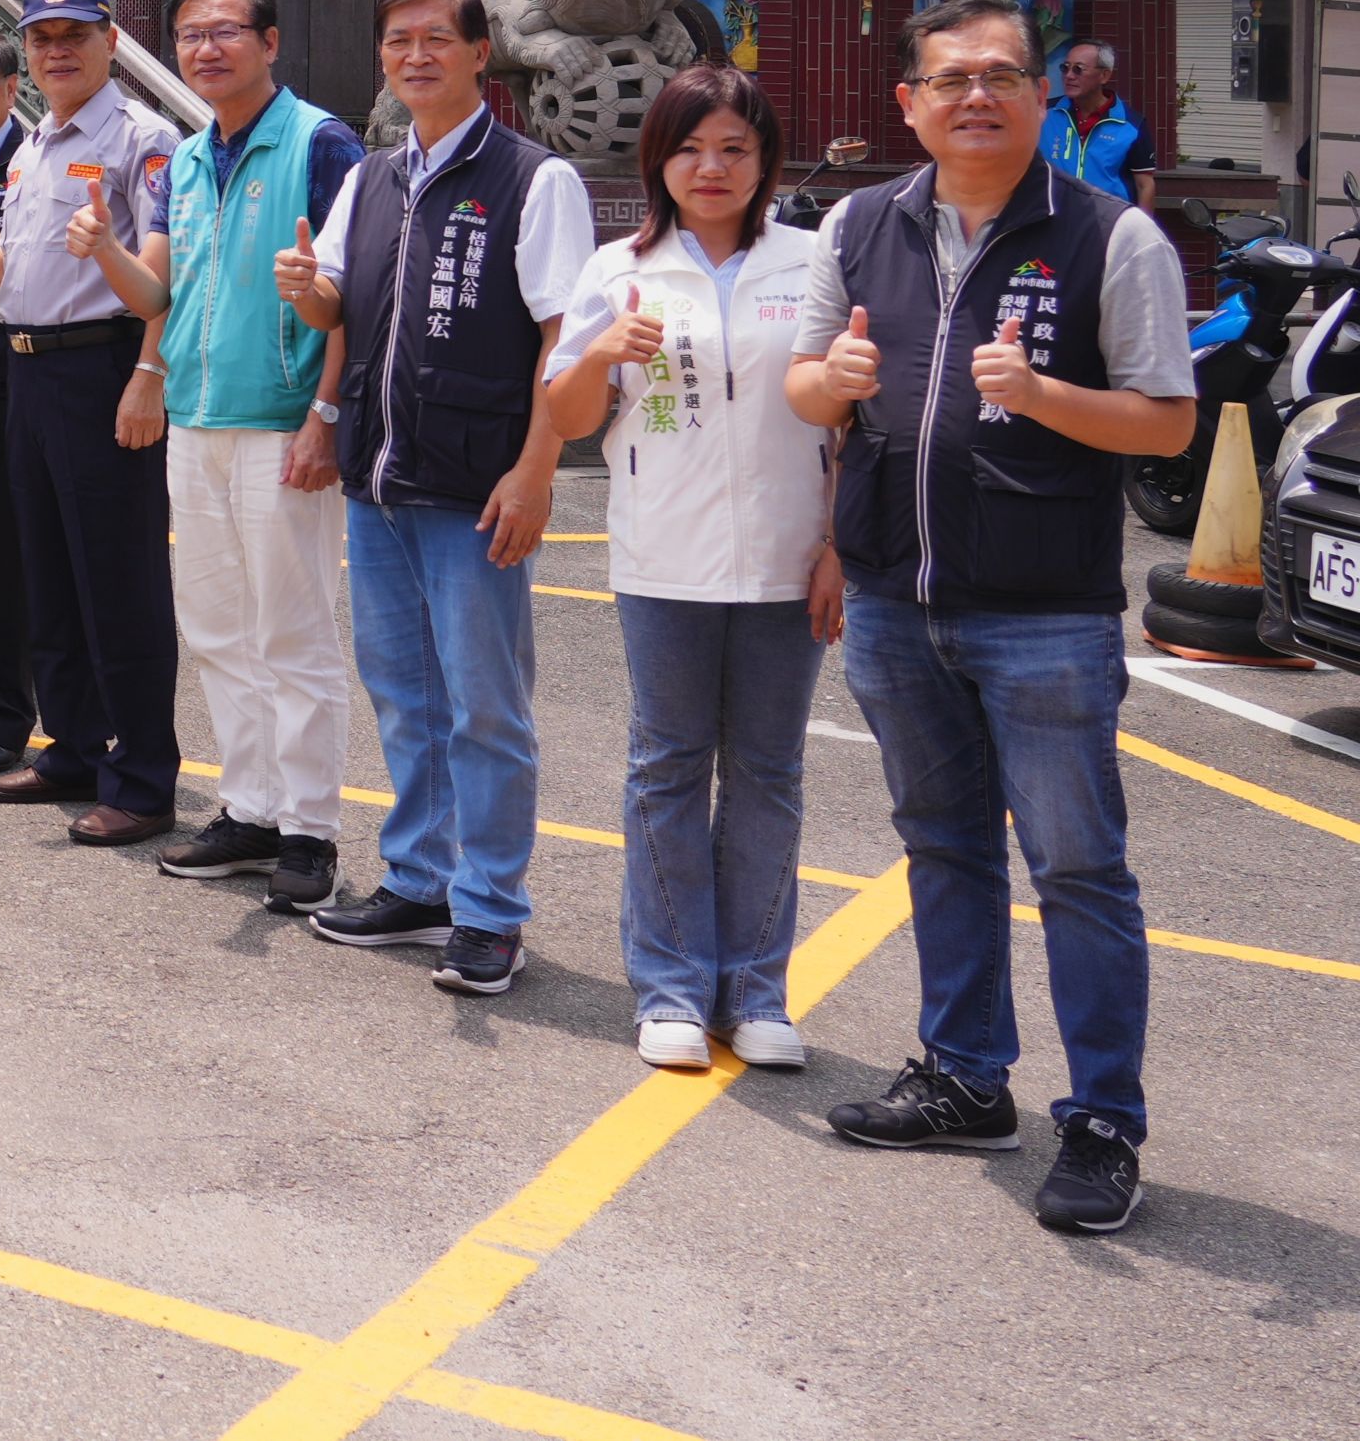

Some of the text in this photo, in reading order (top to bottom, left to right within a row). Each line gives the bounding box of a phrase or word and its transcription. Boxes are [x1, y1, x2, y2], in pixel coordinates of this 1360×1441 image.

[458, 229, 487, 309] 梧棲區公所
[1008, 276, 1057, 290] 臺中市政府
[757, 305, 807, 322] 何欣
[1028, 295, 1058, 367] 民政局
[674, 317, 703, 430] 市議員參選人
